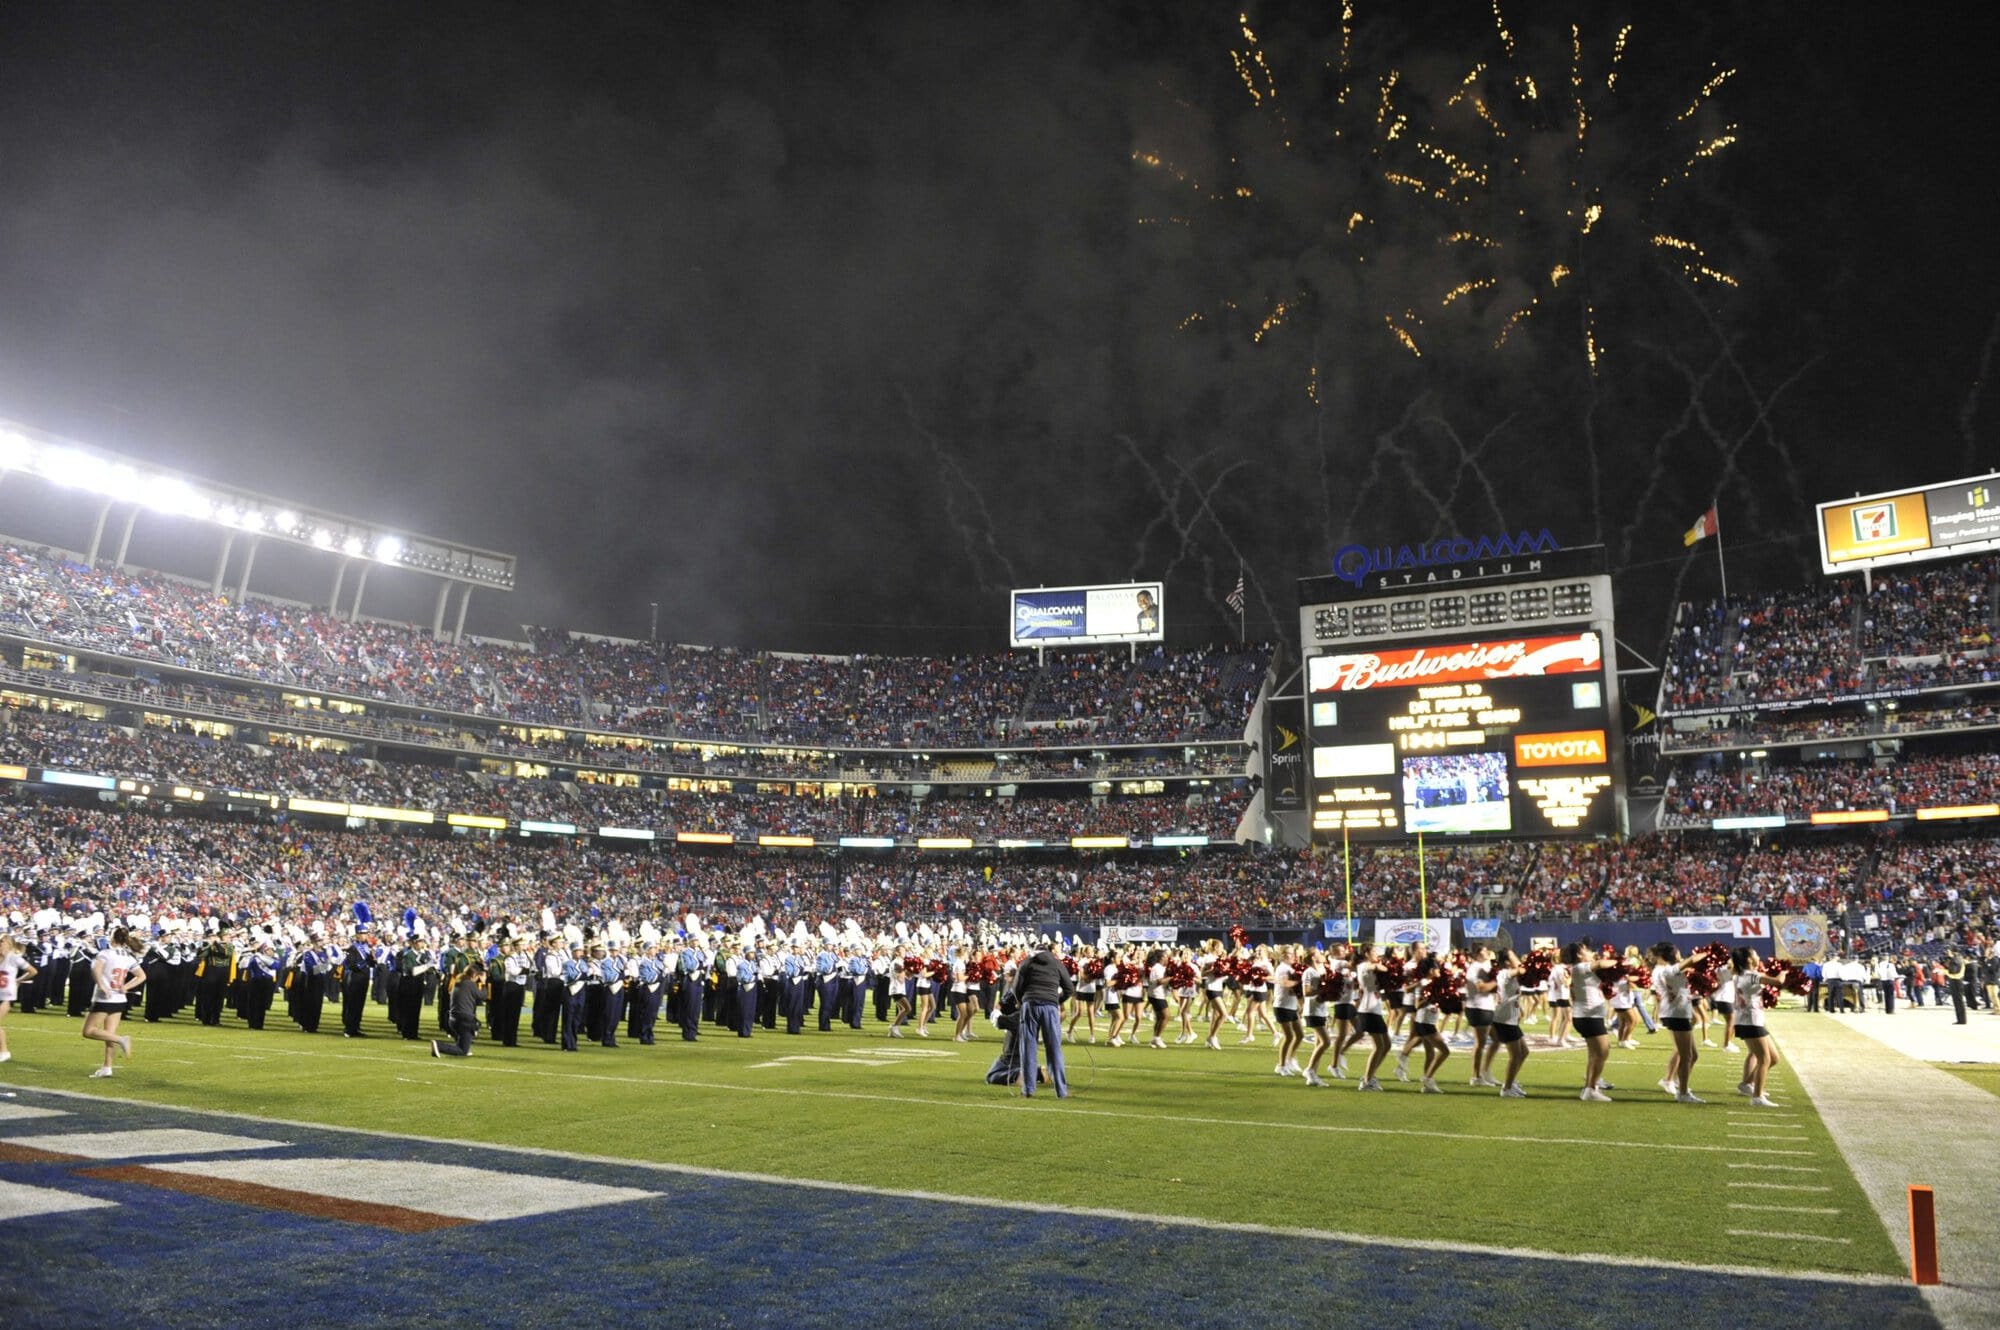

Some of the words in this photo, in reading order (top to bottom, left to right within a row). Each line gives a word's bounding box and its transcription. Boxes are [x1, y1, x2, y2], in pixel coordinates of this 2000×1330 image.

[1931, 511, 1975, 525] Imaging
[1332, 528, 1560, 589] QUALCOMM
[1379, 560, 1542, 587] STADIUM
[1017, 605, 1084, 622] QUALCOMM
[1336, 642, 1526, 690] Budweiser
[1465, 684, 1482, 696] TO
[1409, 701, 1431, 714] DR
[1435, 696, 1493, 712] PEPPER
[1272, 752, 1302, 766] Sprint
[1519, 740, 1602, 760] TOYOTA
[1106, 927, 1122, 942] A
[1739, 918, 1761, 936] N
